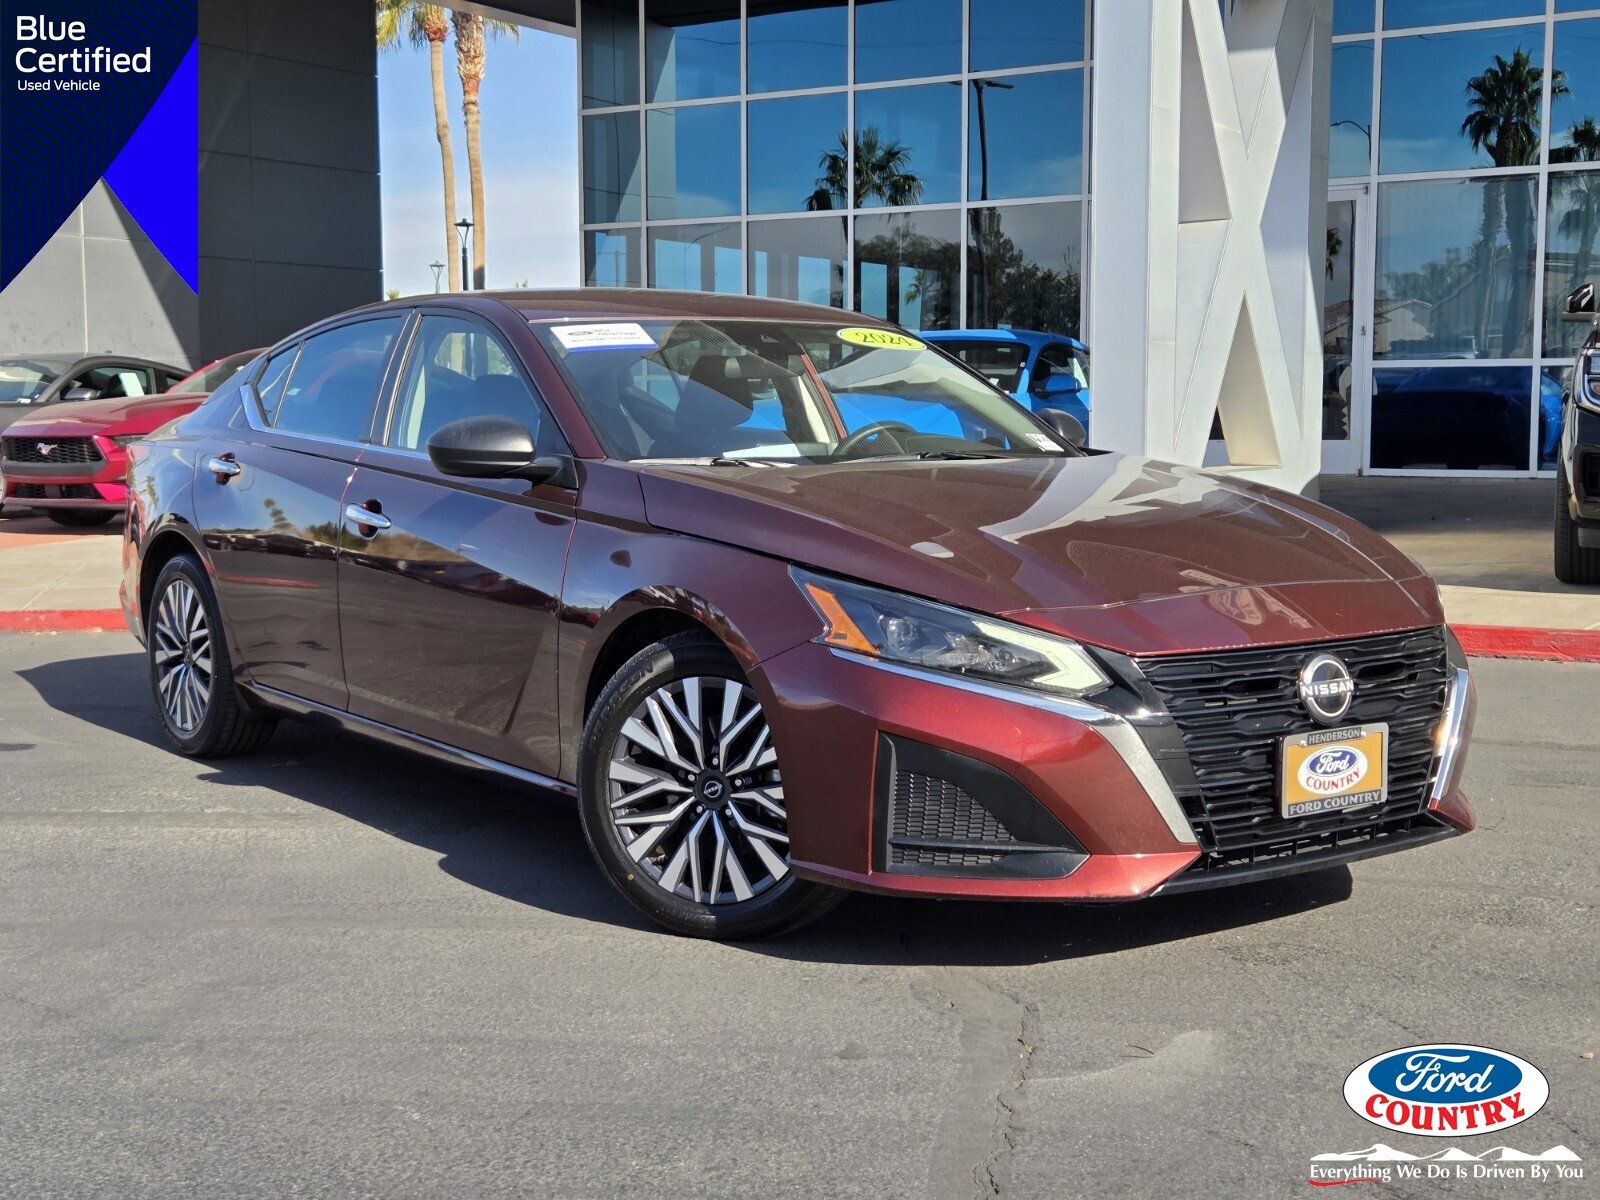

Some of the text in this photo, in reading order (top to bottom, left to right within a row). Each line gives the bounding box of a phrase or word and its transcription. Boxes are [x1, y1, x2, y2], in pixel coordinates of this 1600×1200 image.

[855, 331, 913, 347] 2024
[1301, 679, 1355, 697] NISSAN
[1308, 728, 1361, 745] HENDERSON
[1316, 751, 1350, 773] Ford
[1306, 768, 1360, 791] COUNTRY
[1289, 790, 1381, 816] FORD COUNTRY
